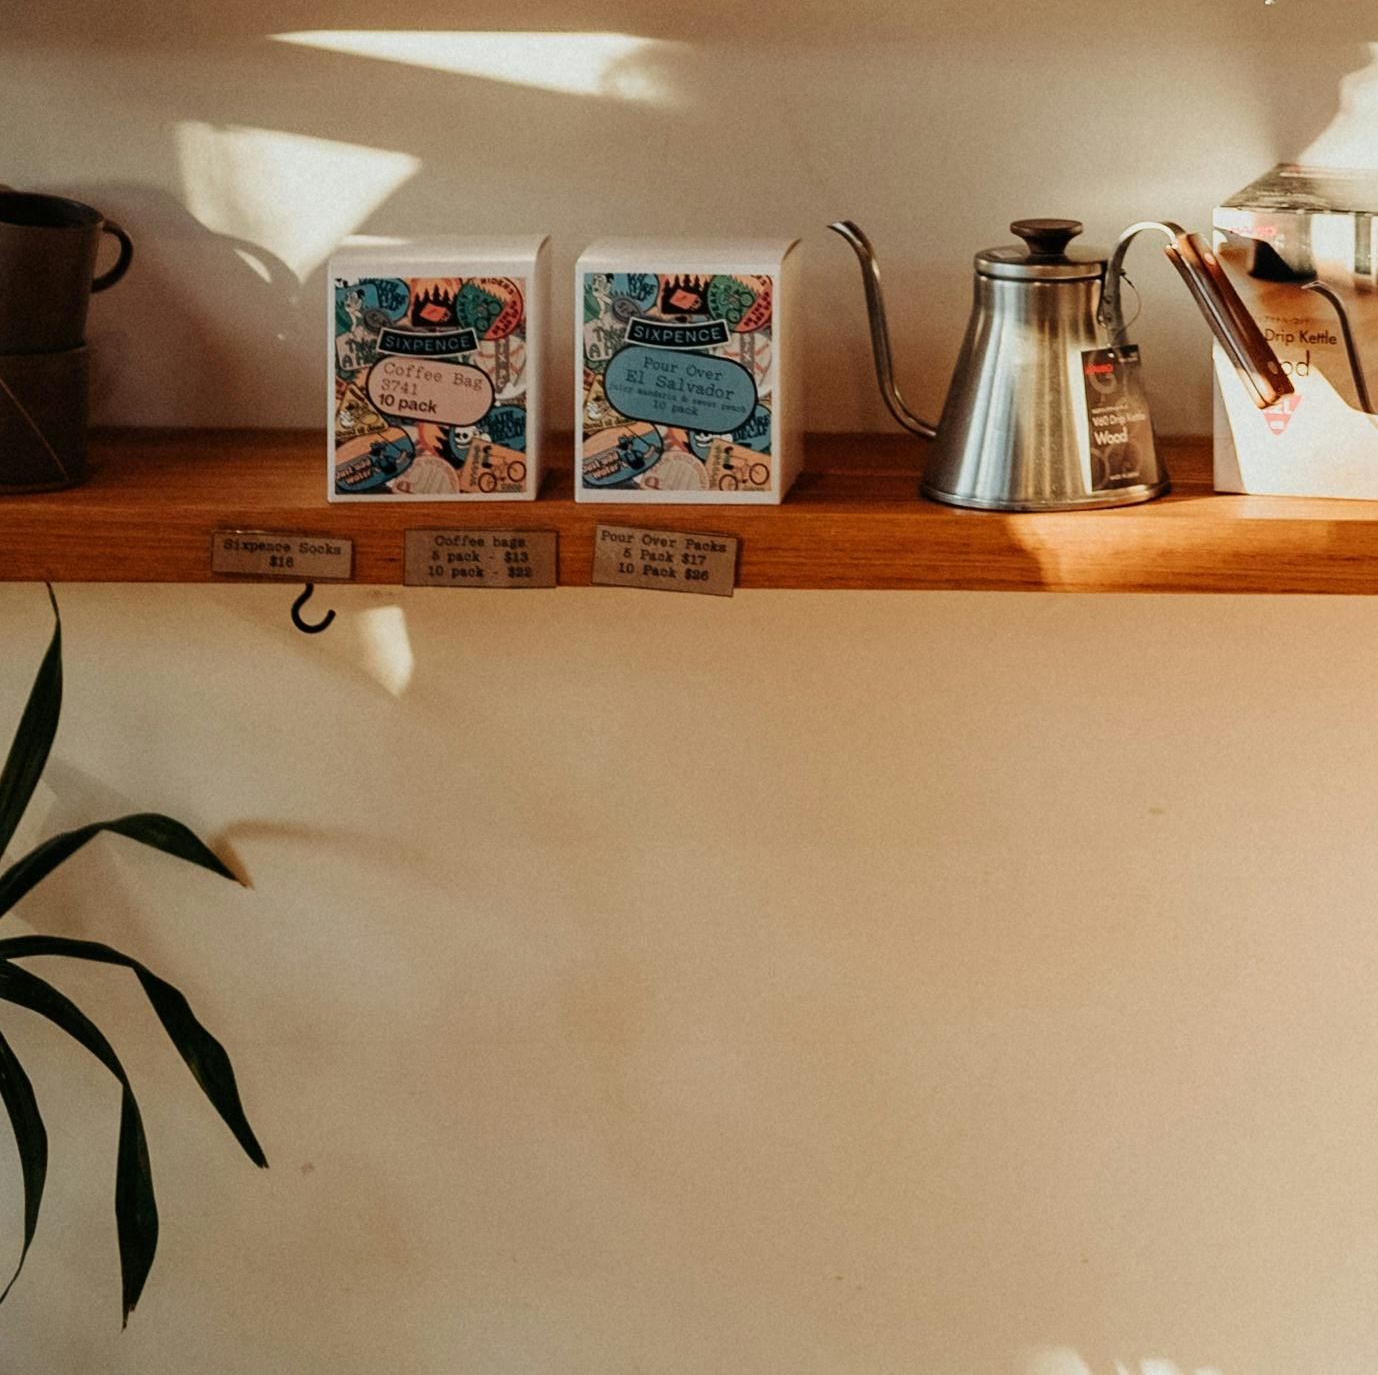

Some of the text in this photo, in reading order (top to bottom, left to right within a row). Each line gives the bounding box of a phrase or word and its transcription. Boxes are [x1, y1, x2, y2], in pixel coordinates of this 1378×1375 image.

[386, 335, 471, 352] SIXPENCE
[633, 326, 721, 343] SIXPENCE
[1265, 329, 1337, 345] Drip Kettle
[383, 362, 483, 391] Coffee Bag
[643, 356, 723, 381] Pour Over
[626, 369, 735, 400] El Salvador
[378, 394, 438, 414] 10 pack
[1094, 427, 1128, 445] Wood
[434, 535, 526, 549] Coffee bags
[601, 531, 727, 553] Pour Over Packs
[618, 563, 634, 574] 10
[643, 564, 676, 578] Pack
